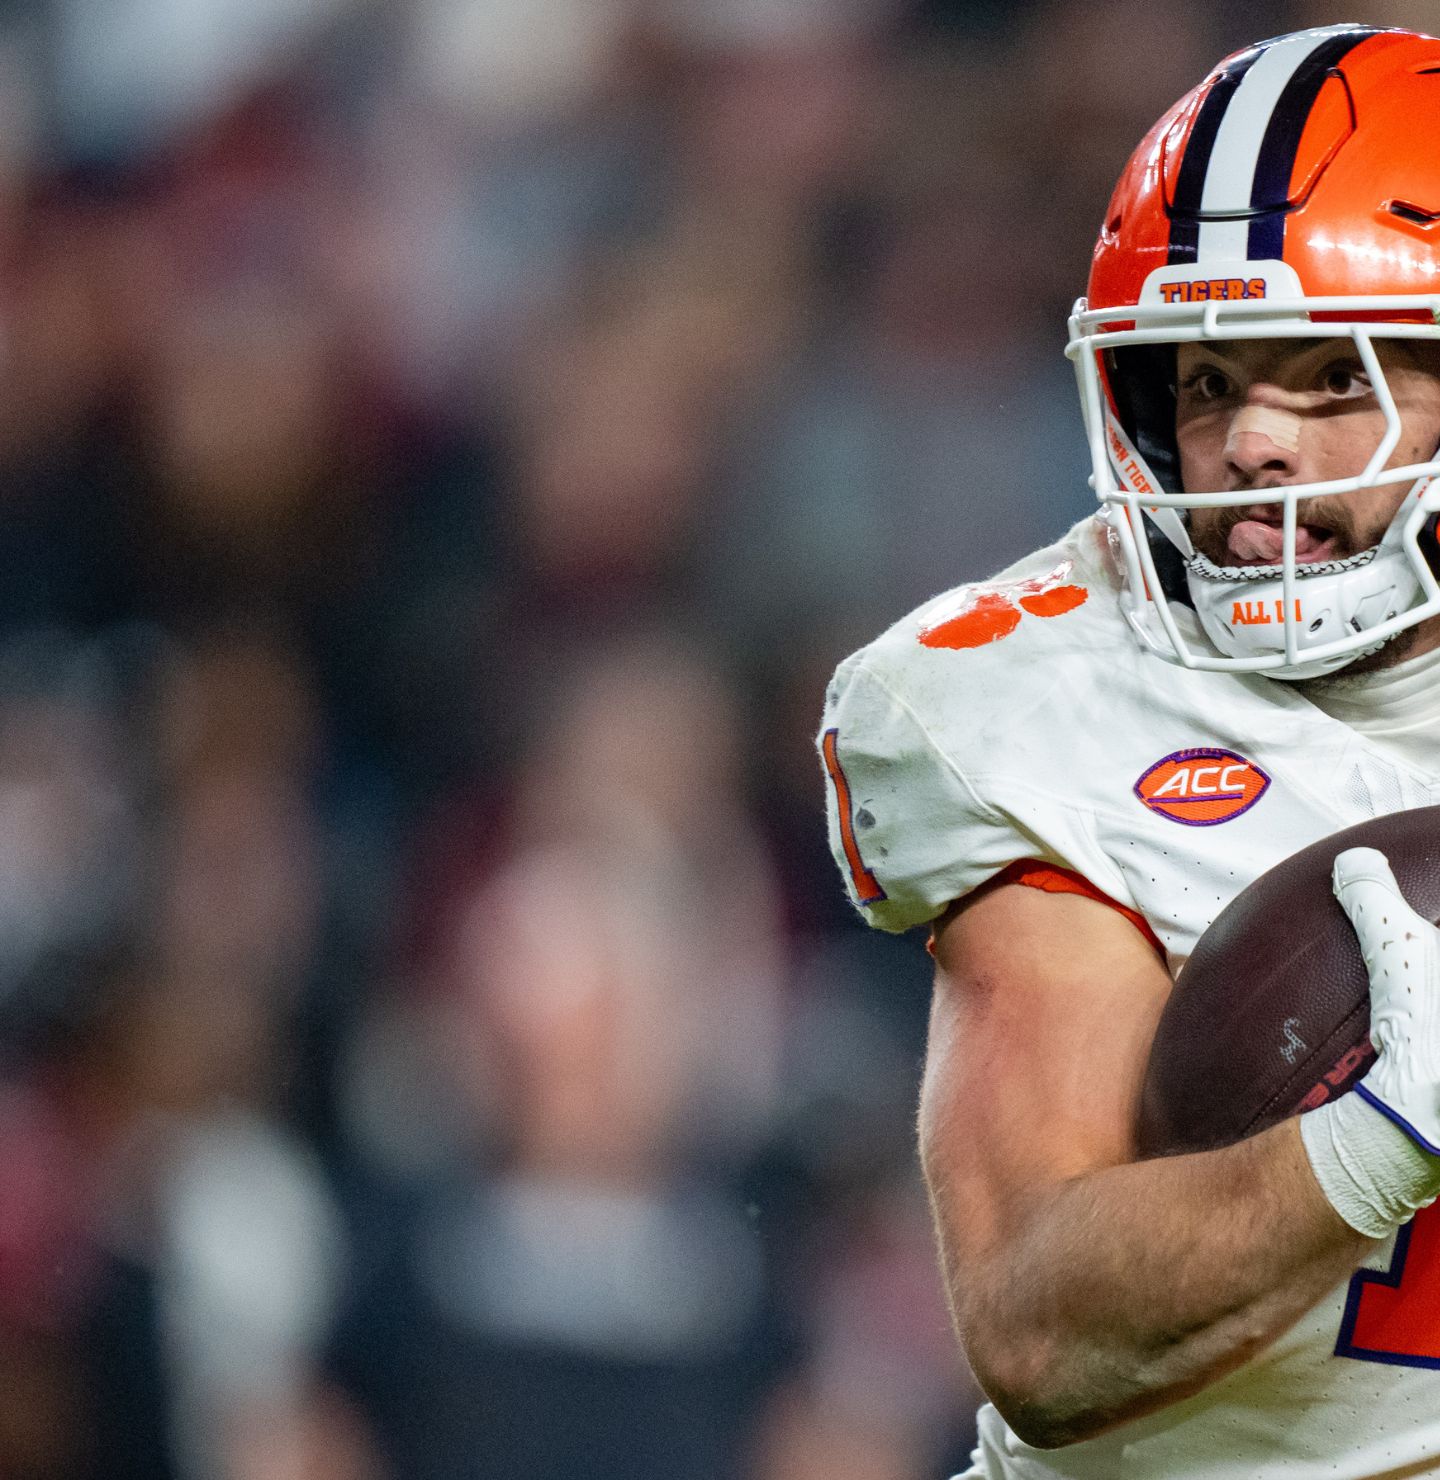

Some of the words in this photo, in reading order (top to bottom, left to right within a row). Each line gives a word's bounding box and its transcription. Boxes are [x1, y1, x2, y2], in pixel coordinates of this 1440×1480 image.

[1160, 278, 1266, 303] TIGERS
[1231, 601, 1271, 625] ALL
[1153, 765, 1249, 797] ACC
